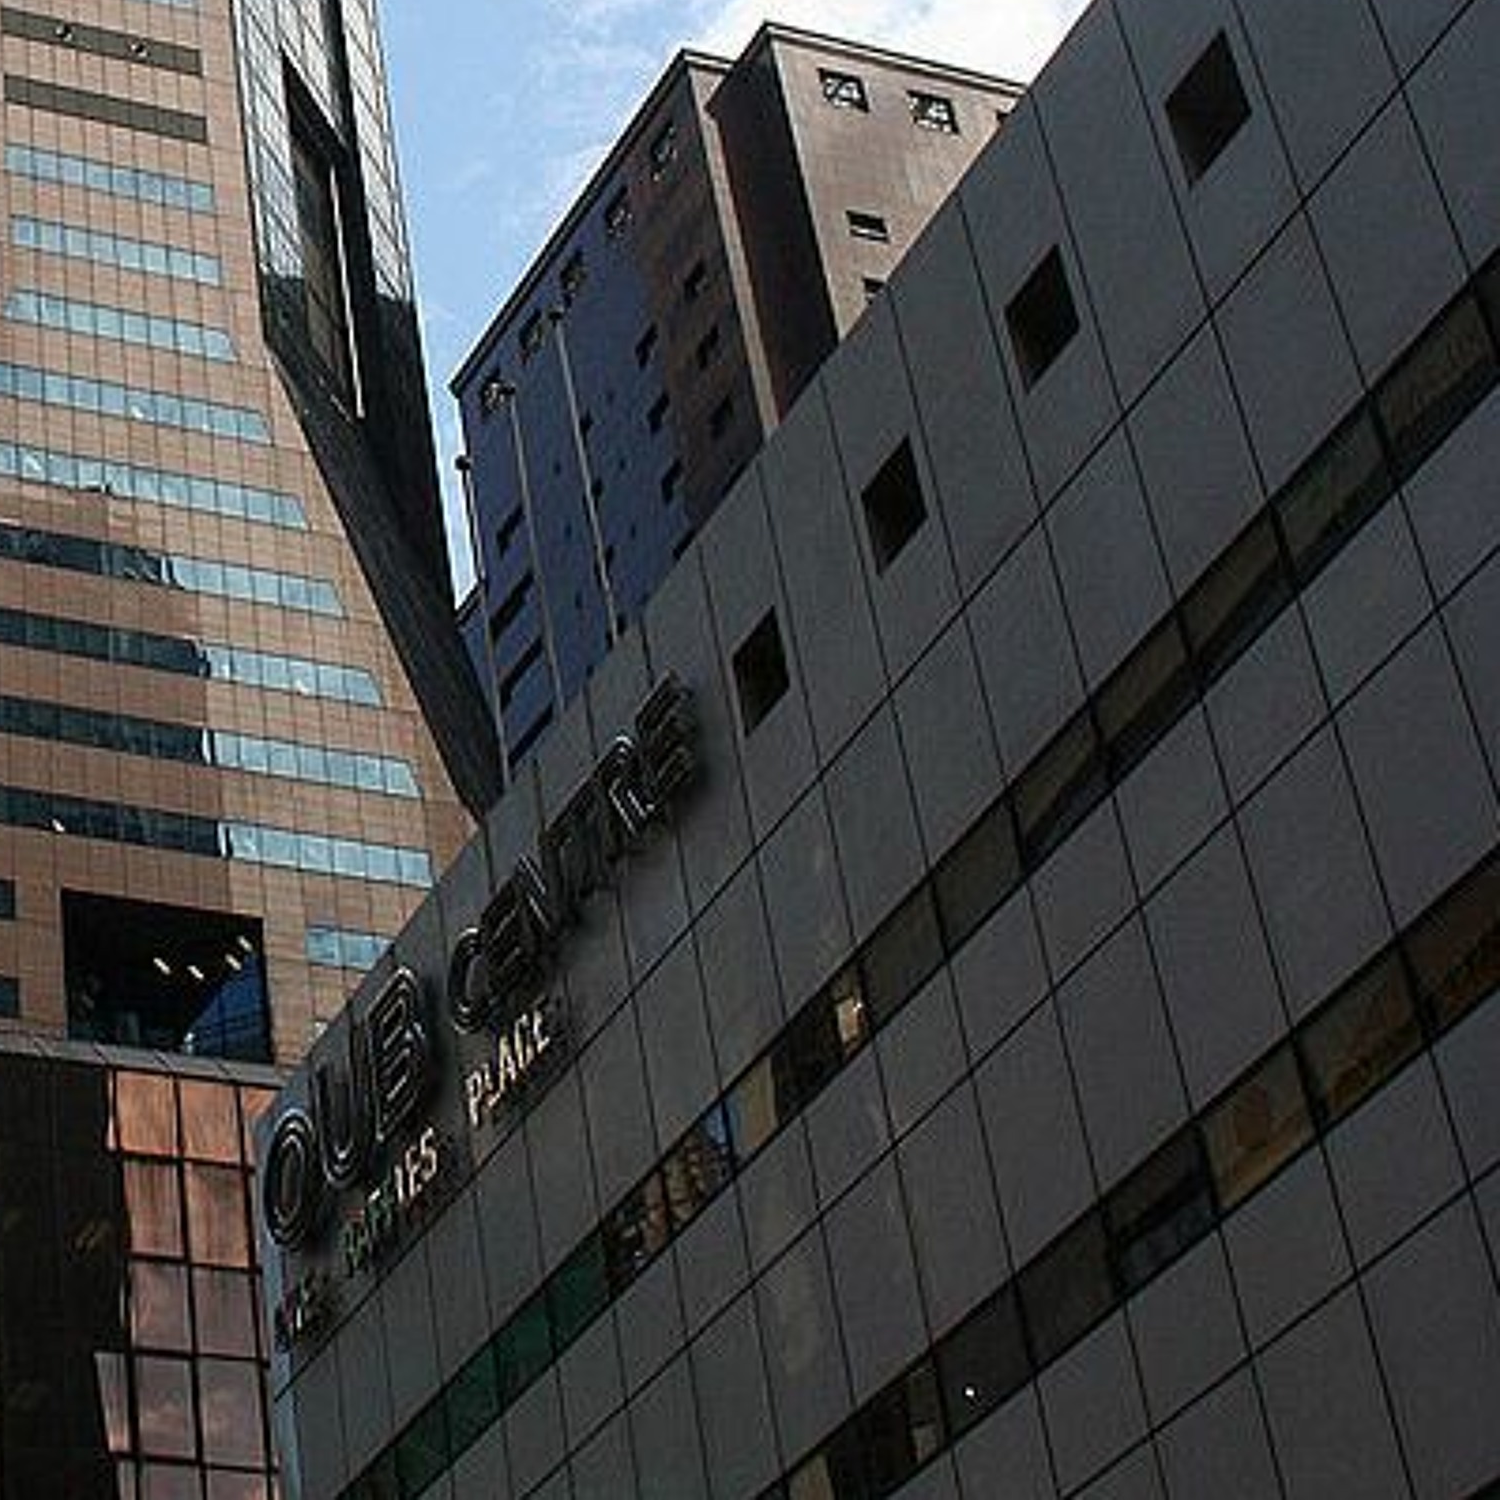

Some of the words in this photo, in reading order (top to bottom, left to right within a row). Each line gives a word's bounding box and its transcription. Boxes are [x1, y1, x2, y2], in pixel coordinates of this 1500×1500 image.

[263, 966, 427, 1250] OUB
[448, 670, 696, 1035] CENTRE
[466, 997, 550, 1127] PLACE
